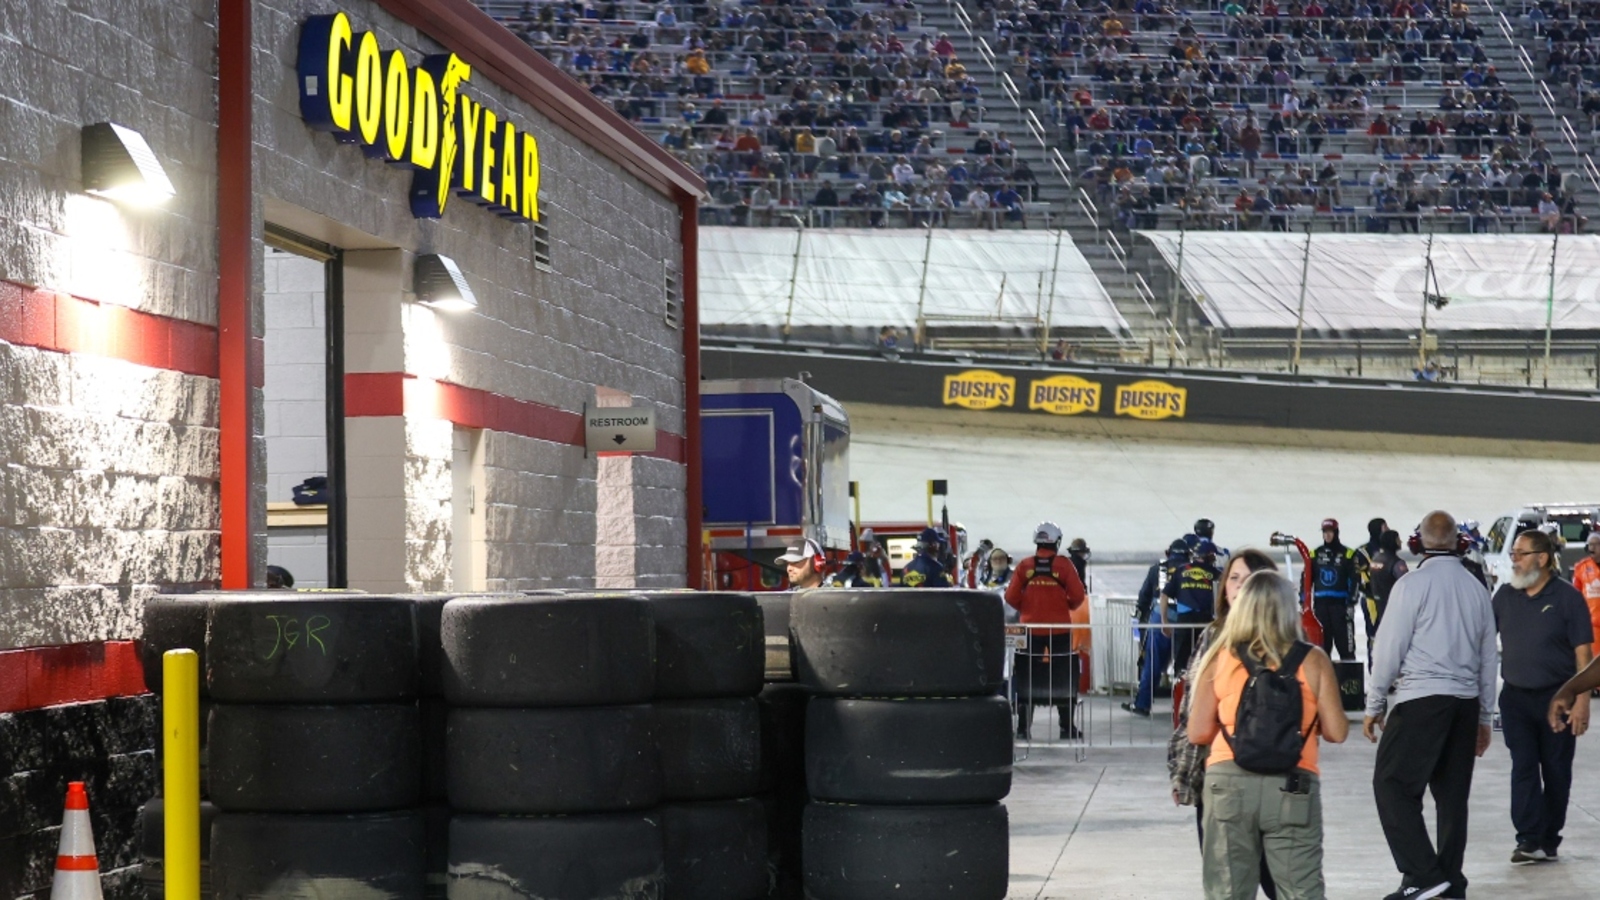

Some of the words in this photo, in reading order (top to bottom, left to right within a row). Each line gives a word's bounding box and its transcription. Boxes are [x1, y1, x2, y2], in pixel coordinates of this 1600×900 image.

[327, 12, 541, 222] GOODYEAR
[948, 380, 1010, 402] BUSH'S
[1034, 385, 1095, 407] BUSH'S
[1120, 390, 1181, 412] BUSH'S
[588, 416, 649, 428] RESTROOM
[264, 615, 331, 660] JGR
